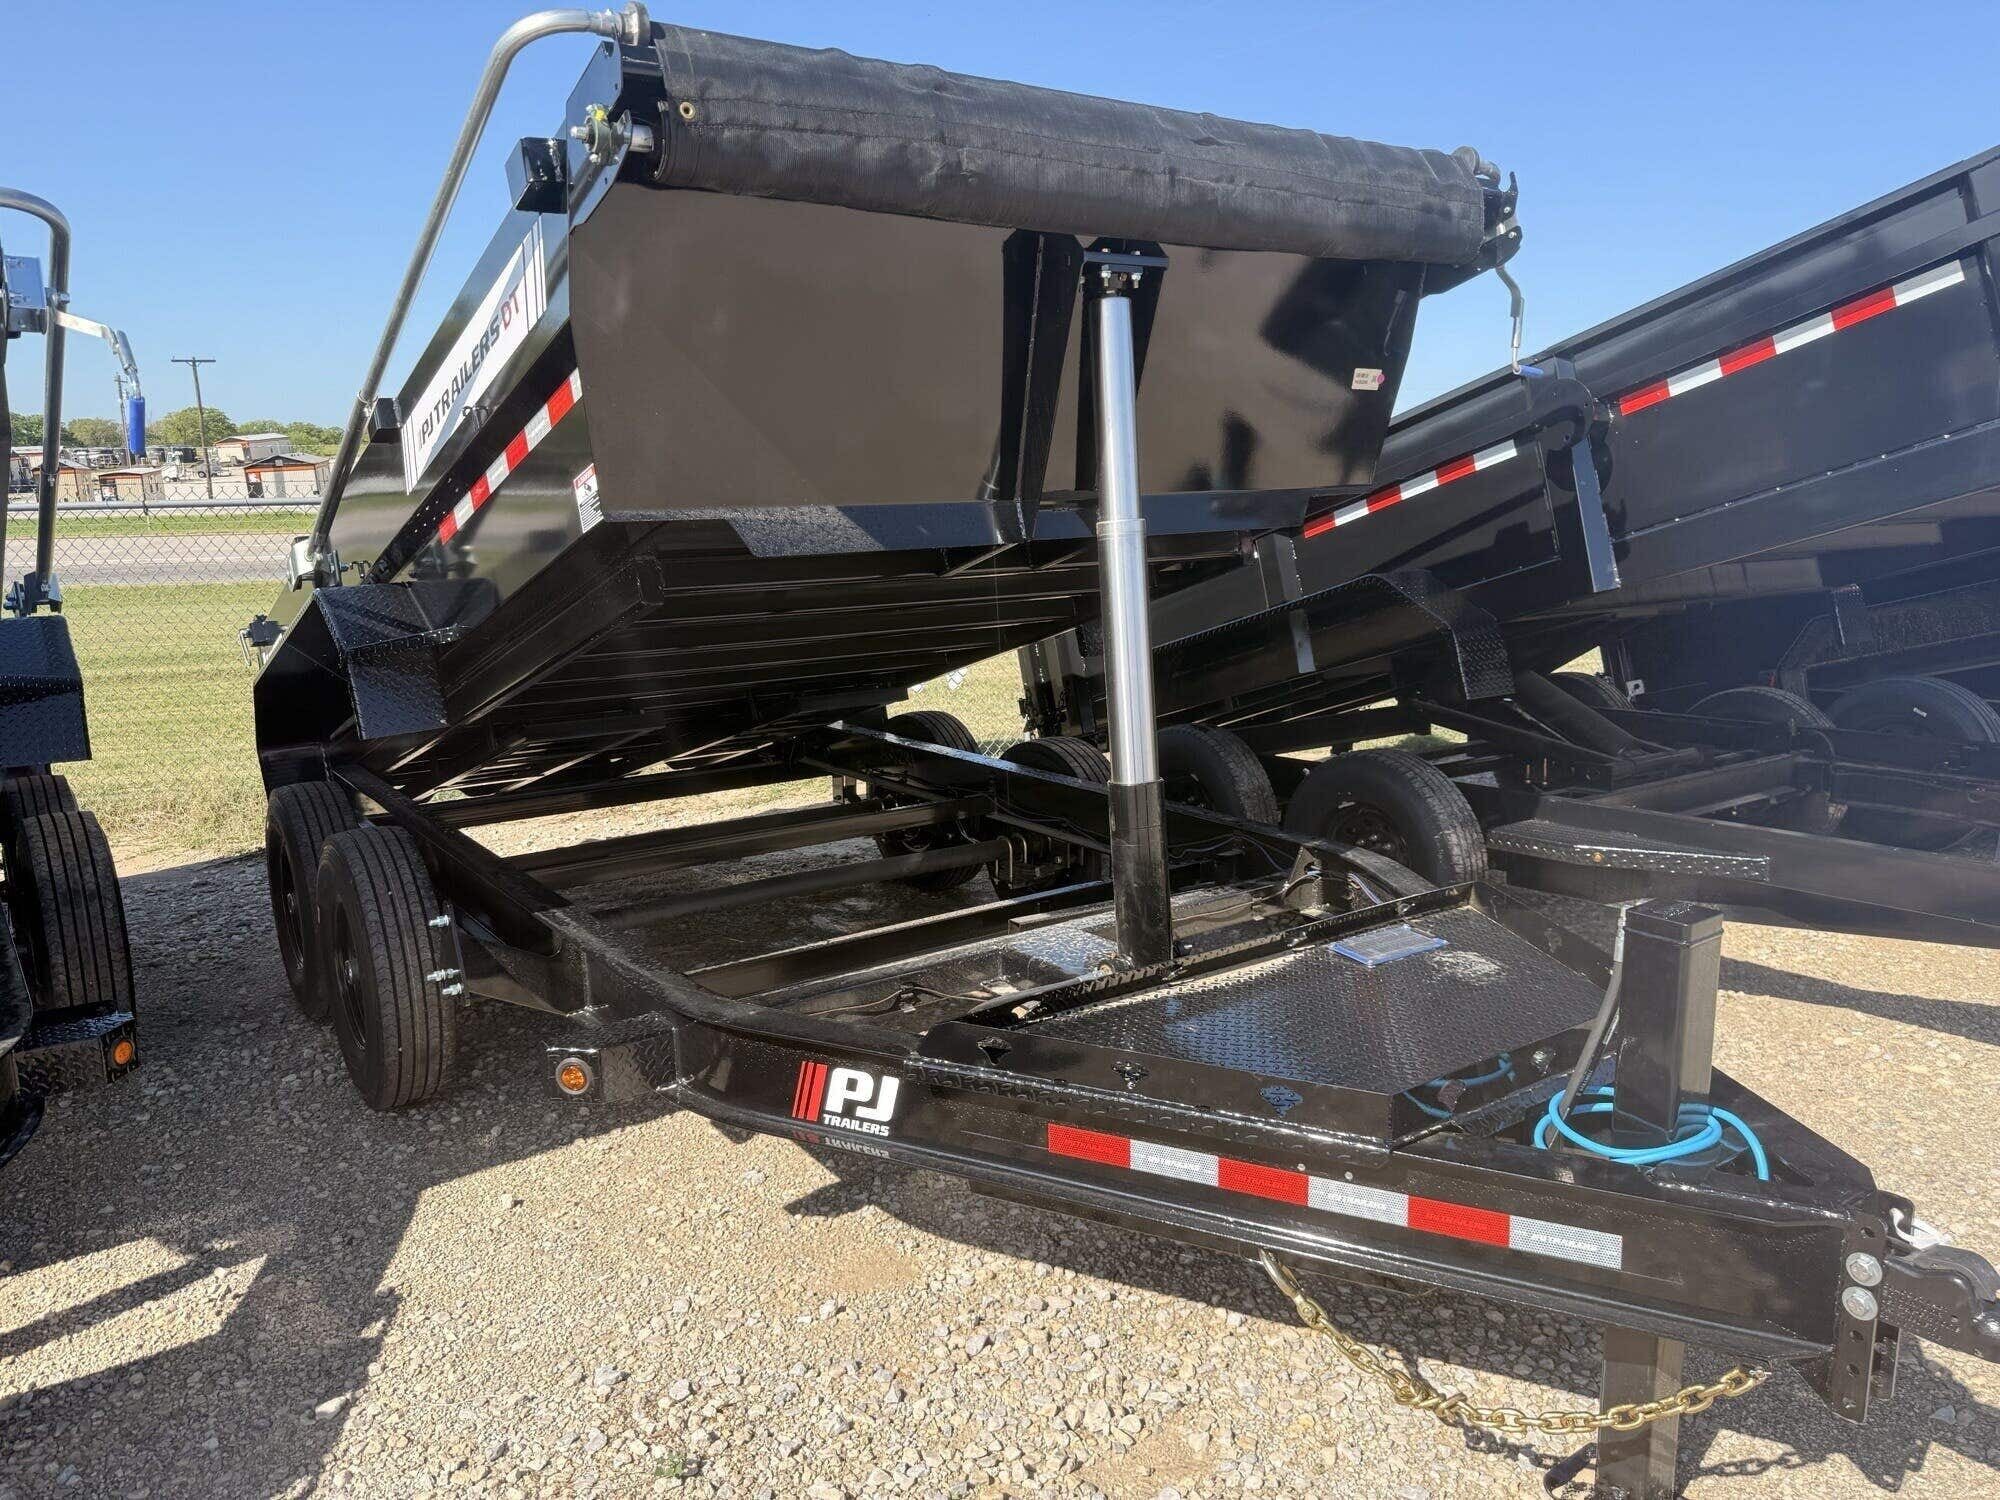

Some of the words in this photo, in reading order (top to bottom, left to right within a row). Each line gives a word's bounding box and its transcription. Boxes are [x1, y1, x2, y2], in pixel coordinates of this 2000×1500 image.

[421, 411, 434, 445] PJ
[433, 314, 500, 424] TRAILERS
[501, 283, 520, 330] DT
[825, 1067, 900, 1122] PJ
[823, 1113, 890, 1137] TRAILERS
